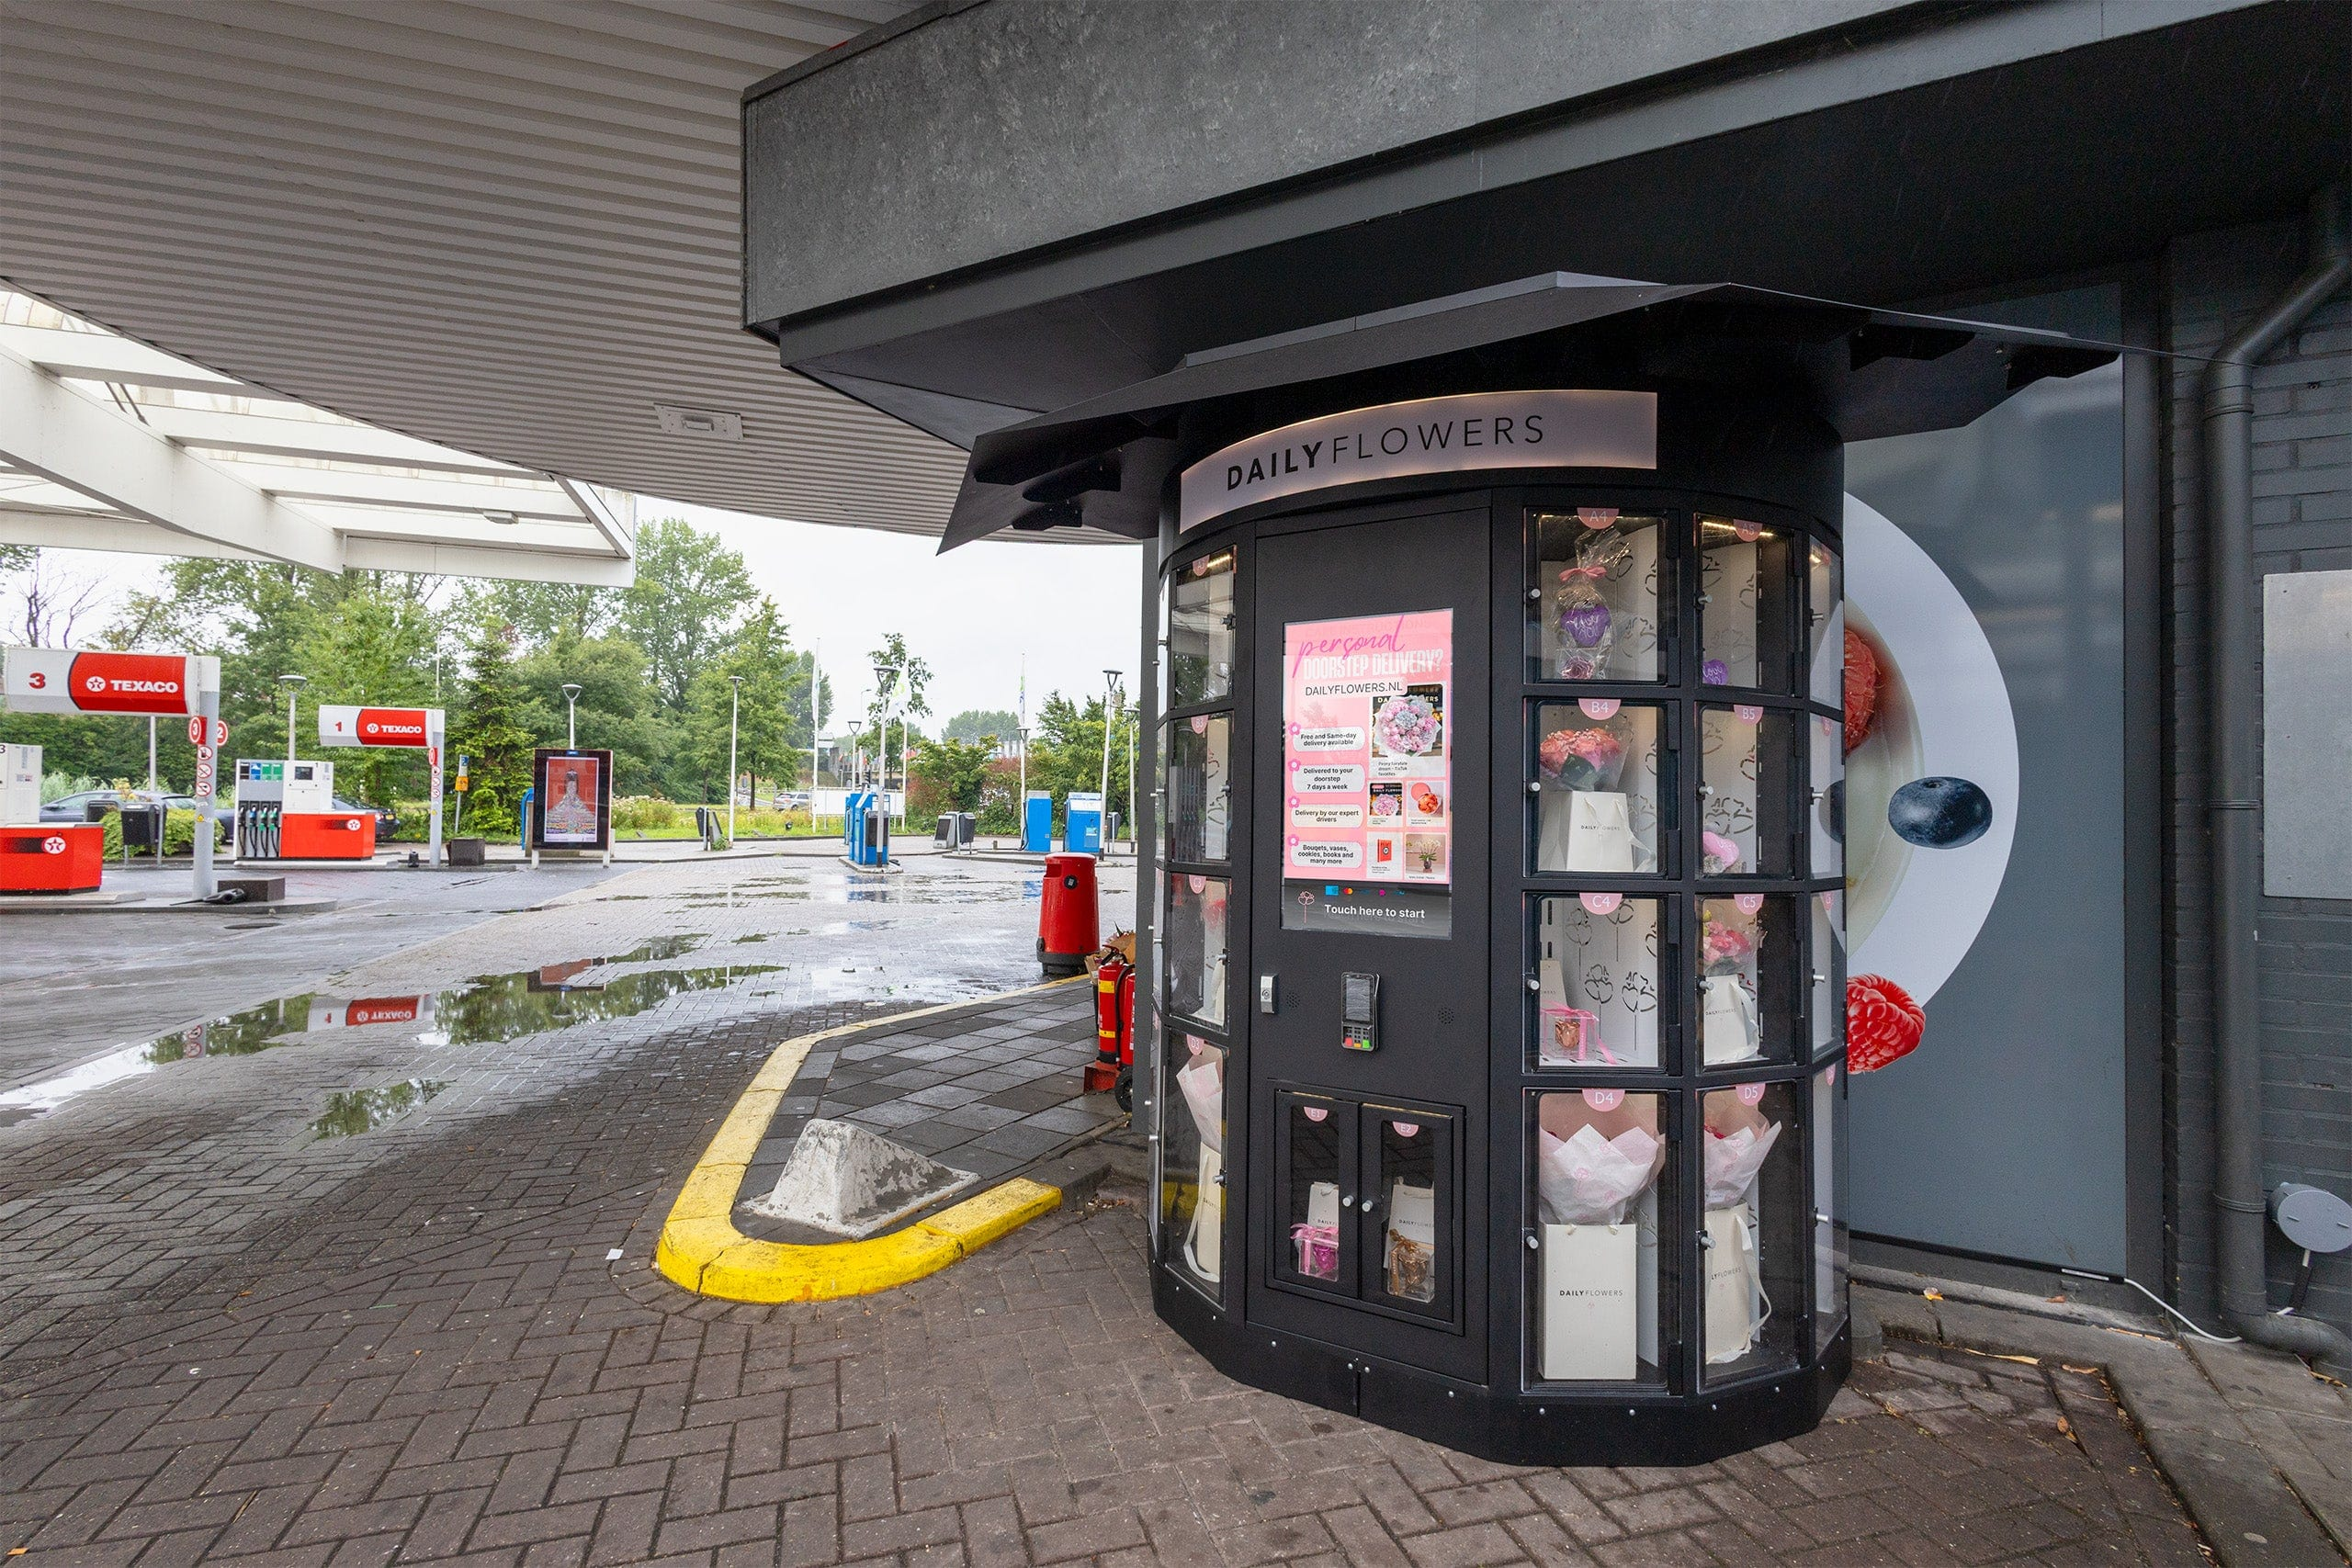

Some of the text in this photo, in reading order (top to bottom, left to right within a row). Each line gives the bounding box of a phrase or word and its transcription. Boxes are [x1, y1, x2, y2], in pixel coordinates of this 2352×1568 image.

[1227, 415, 1544, 491] DAILYFLOWERS
[1589, 510, 1608, 523] A4
[1292, 615, 1406, 678] personal
[1303, 649, 1444, 679] DOORSTEP DELIVERY?
[28, 672, 178, 694] 3 TEXACO
[1305, 682, 1403, 696] DAILYFLOWERS.NL
[1591, 701, 1609, 713] B4
[1742, 707, 1755, 720] B5
[192, 722, 198, 736] 3
[334, 721, 423, 734] 1 TEXACO
[1592, 895, 1611, 908] C4
[1742, 896, 1756, 908] C5
[1324, 904, 1426, 919] Touch here to start
[1594, 1091, 1614, 1104] D4
[1745, 1086, 1758, 1100] D5
[1310, 1110, 1320, 1118] E1
[1400, 1123, 1411, 1133] E2
